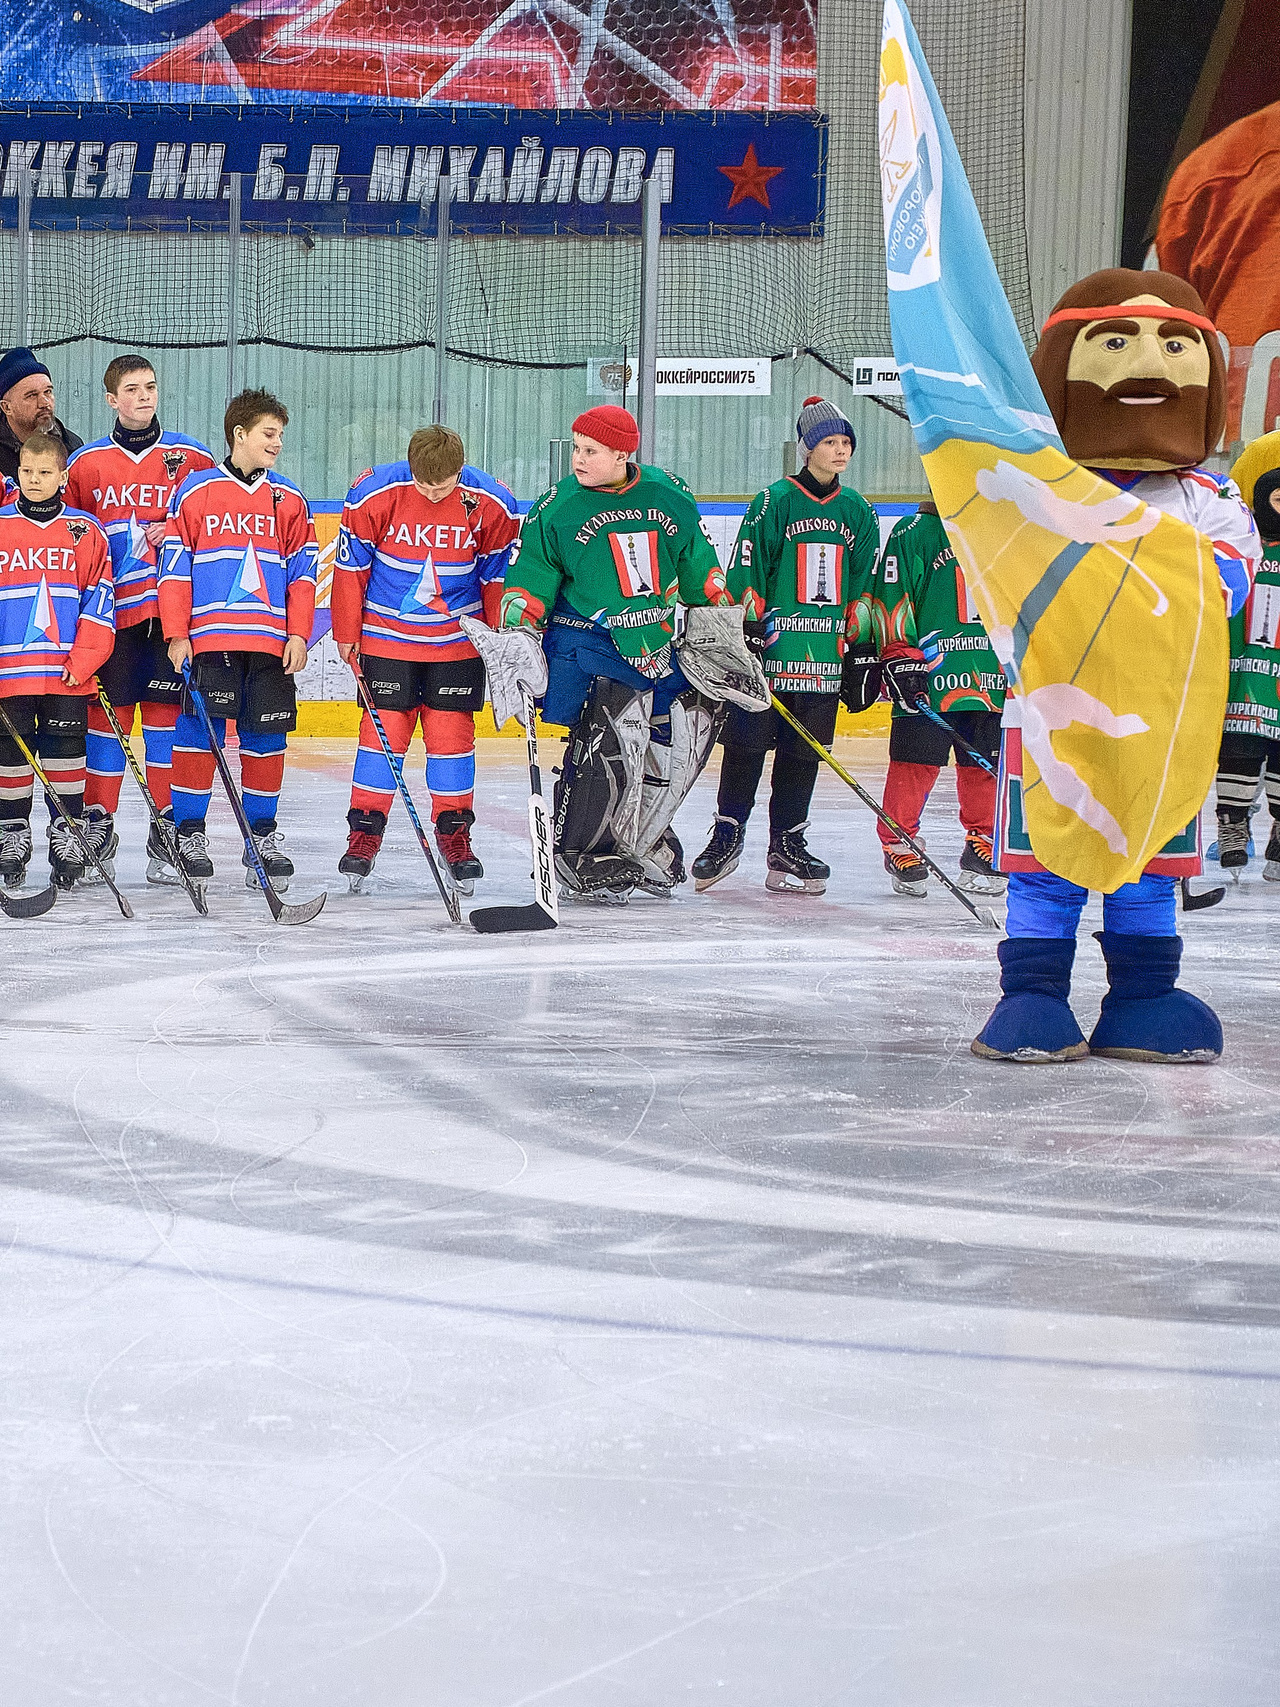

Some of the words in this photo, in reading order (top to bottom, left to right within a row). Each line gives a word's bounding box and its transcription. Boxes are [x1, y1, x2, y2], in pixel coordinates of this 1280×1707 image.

[252, 143, 350, 201] Б.П.
[367, 136, 675, 203] МИХАЙЛОВА
[656, 367, 756, 385] ОККЕЙРОССИИ75
[205, 512, 276, 538] РАКЕТ
[884, 554, 899, 584] 8
[774, 616, 833, 633] КУРКИНСКИЙ
[148, 680, 183, 691] BAU
[438, 687, 473, 695] EFSI
[934, 672, 971, 691] ООО
[980, 672, 1007, 692] ДЖЕ
[260, 711, 291, 722] EFSI
[553, 787, 572, 847] Reebok
[535, 805, 554, 910] FISCHER
